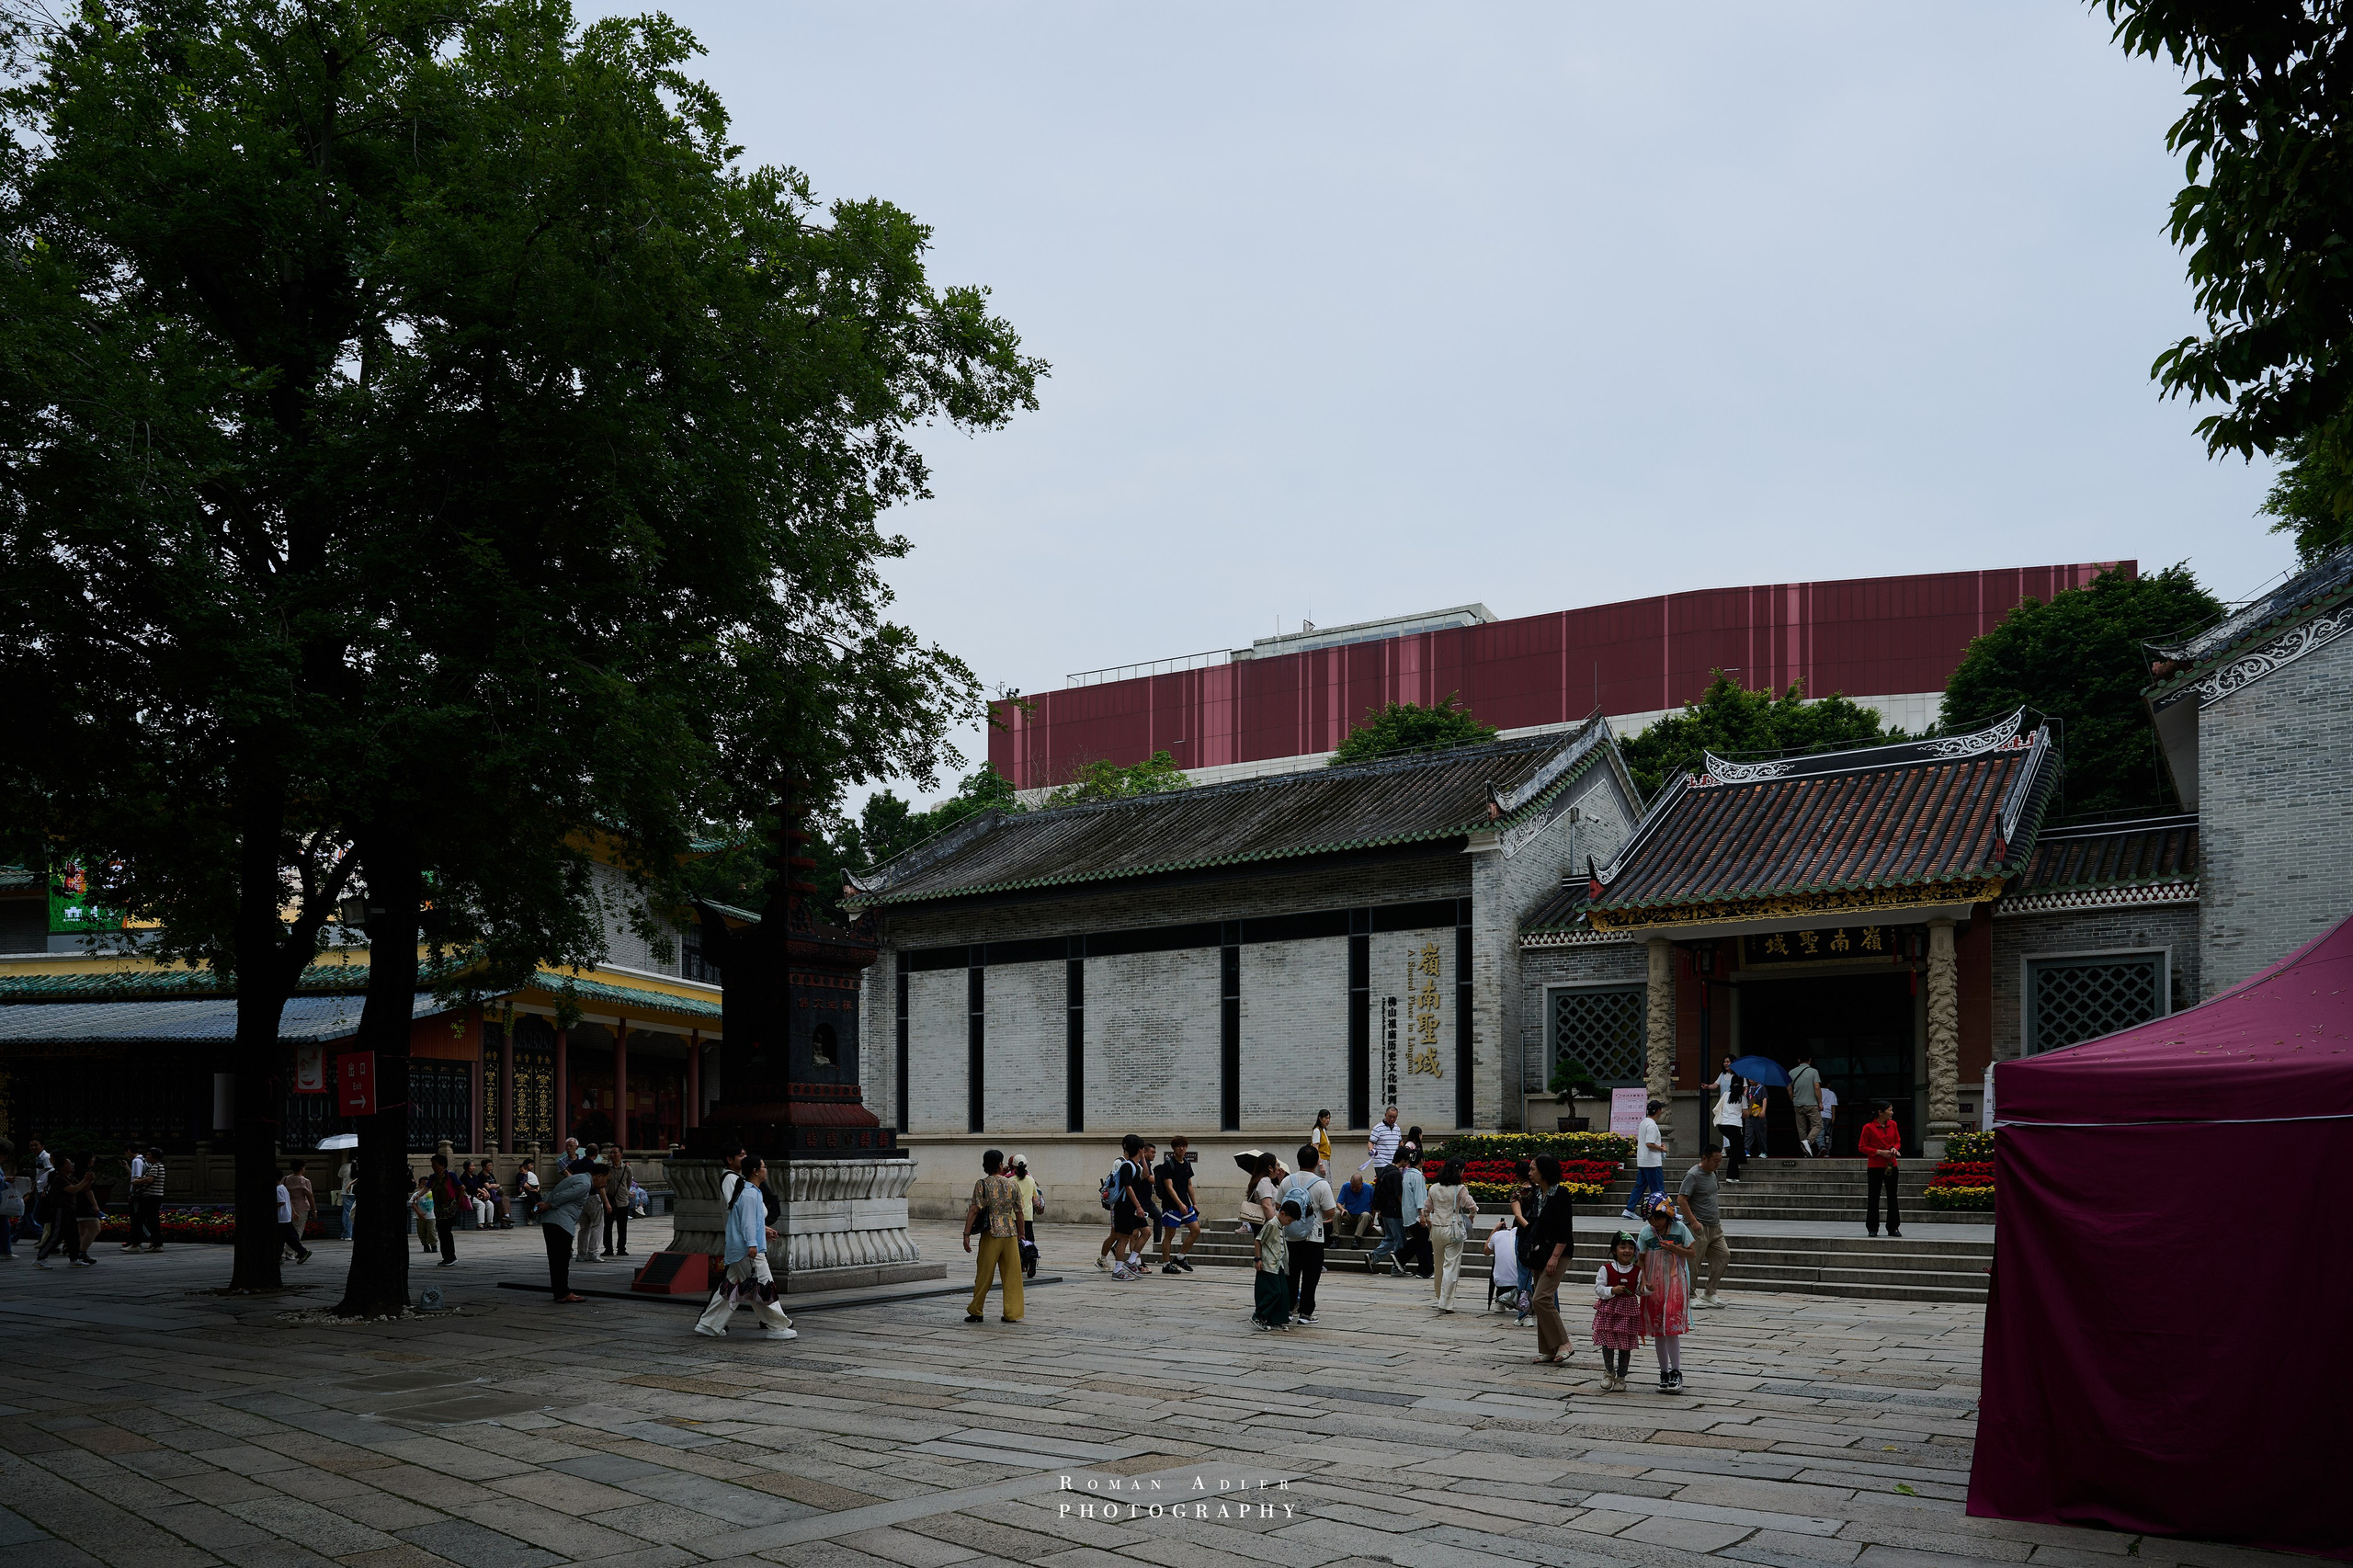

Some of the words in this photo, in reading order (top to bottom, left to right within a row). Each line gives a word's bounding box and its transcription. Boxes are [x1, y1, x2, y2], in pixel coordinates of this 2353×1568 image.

[1407, 949, 1415, 958] A
[1765, 925, 1882, 956] 嶺南聖域
[1407, 961, 1415, 991] Sacred
[1407, 994, 1415, 1019] Place
[1414, 941, 1443, 1078] 嶺南聖域
[1407, 1022, 1415, 1032] in
[1387, 996, 1397, 1106] 佛山祖庙历史文化陈列
[1405, 1036, 1415, 1074] Lingnan
[348, 1062, 366, 1077] 出口
[353, 1082, 362, 1091] Exit
